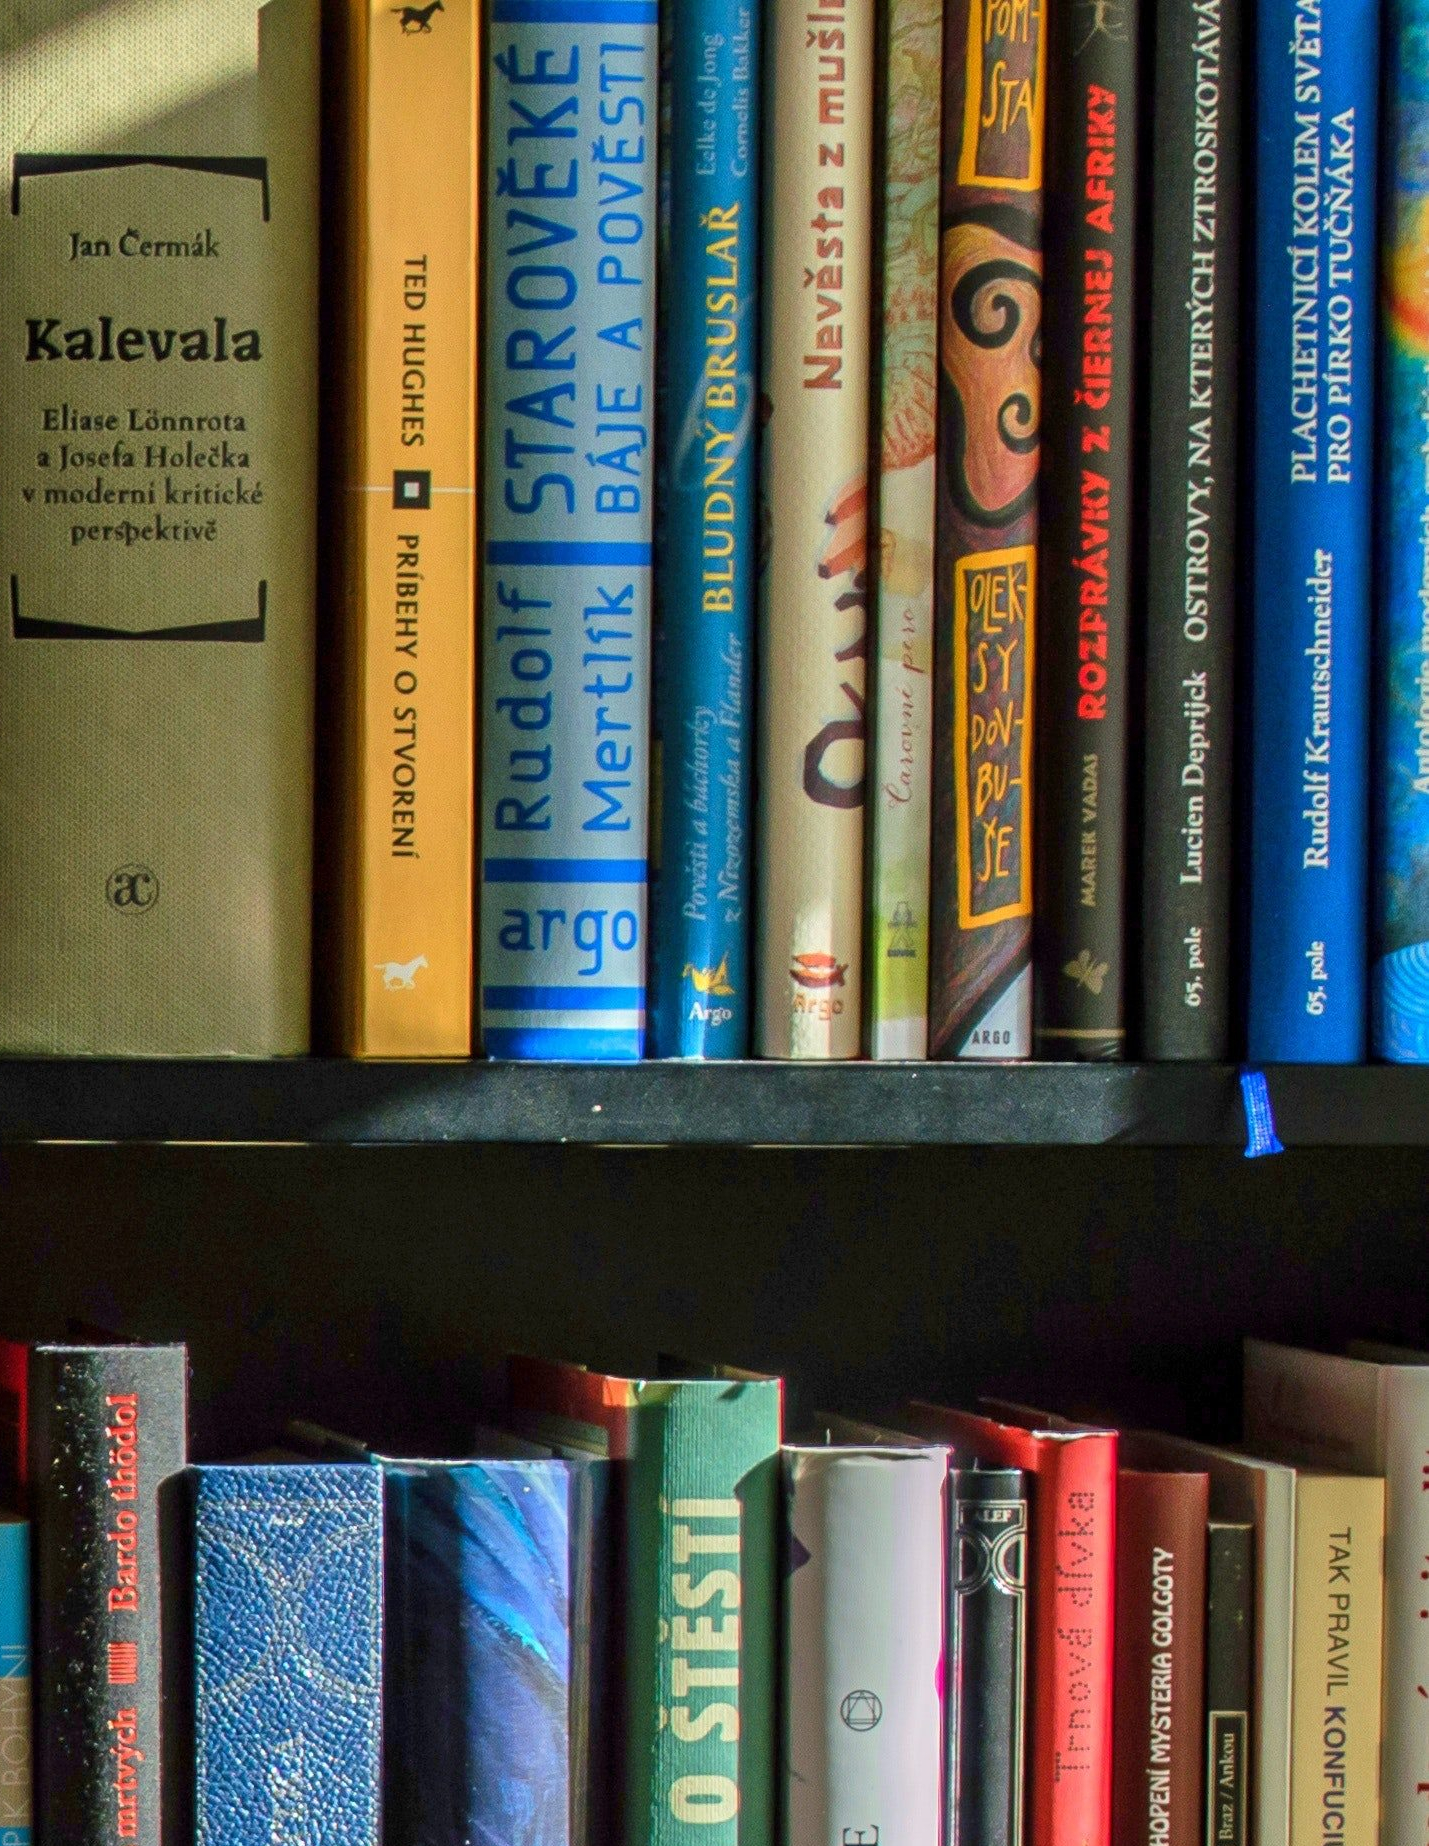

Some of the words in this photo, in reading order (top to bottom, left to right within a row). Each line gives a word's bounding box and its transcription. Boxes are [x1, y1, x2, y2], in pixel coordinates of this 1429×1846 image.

[589, 40, 645, 286] POVĚSTI
[1084, 83, 1116, 233] AFRIKY
[1291, 111, 1322, 238] KOLEM
[70, 230, 112, 261] Jan
[403, 253, 428, 312] TED
[494, 44, 579, 516] STAROVĚKÉ
[802, 186, 844, 391] Nevěsta
[23, 315, 263, 363] Kalevala
[698, 202, 740, 409] BRUSLAŘ
[1073, 248, 1113, 410] ČIERNEJ
[41, 402, 117, 432] Eliase
[400, 322, 427, 448] HUGHES
[1286, 245, 1320, 485] PLACHETNICÍ
[58, 441, 136, 474] Josefa
[585, 384, 647, 516] BÁJE
[1326, 413, 1353, 485] PRO
[694, 420, 738, 613] BLUDNÝ
[393, 533, 425, 659] PRÍBEHY
[1071, 469, 1111, 721] ROZPRÁVKY
[494, 579, 554, 834] Rudolf
[581, 582, 634, 832] Mertlík
[391, 706, 421, 860] STVORENÍ
[1180, 795, 1205, 885] Lucien
[1303, 770, 1331, 870] Rudolf
[1080, 830, 1098, 908] MAREK
[498, 909, 639, 977] argo
[104, 1392, 138, 1501] thödol
[105, 1511, 140, 1612] Bardo
[1053, 1490, 1096, 1608] dívka
[1151, 1547, 1175, 1647] GOLGOTY
[1327, 1526, 1352, 1584] TAK
[656, 1497, 742, 1743] ŠTĚSTÍ
[1326, 1593, 1351, 1697] PRAVIL
[1052, 1627, 1093, 1783] Trnová
[1148, 1652, 1173, 1764] MYSTERIA
[1217, 1732, 1235, 1788] Ankou
[109, 1707, 144, 1839] mrtvých
[669, 1774, 740, 1824] O
[1217, 1803, 1234, 1840] Braz
